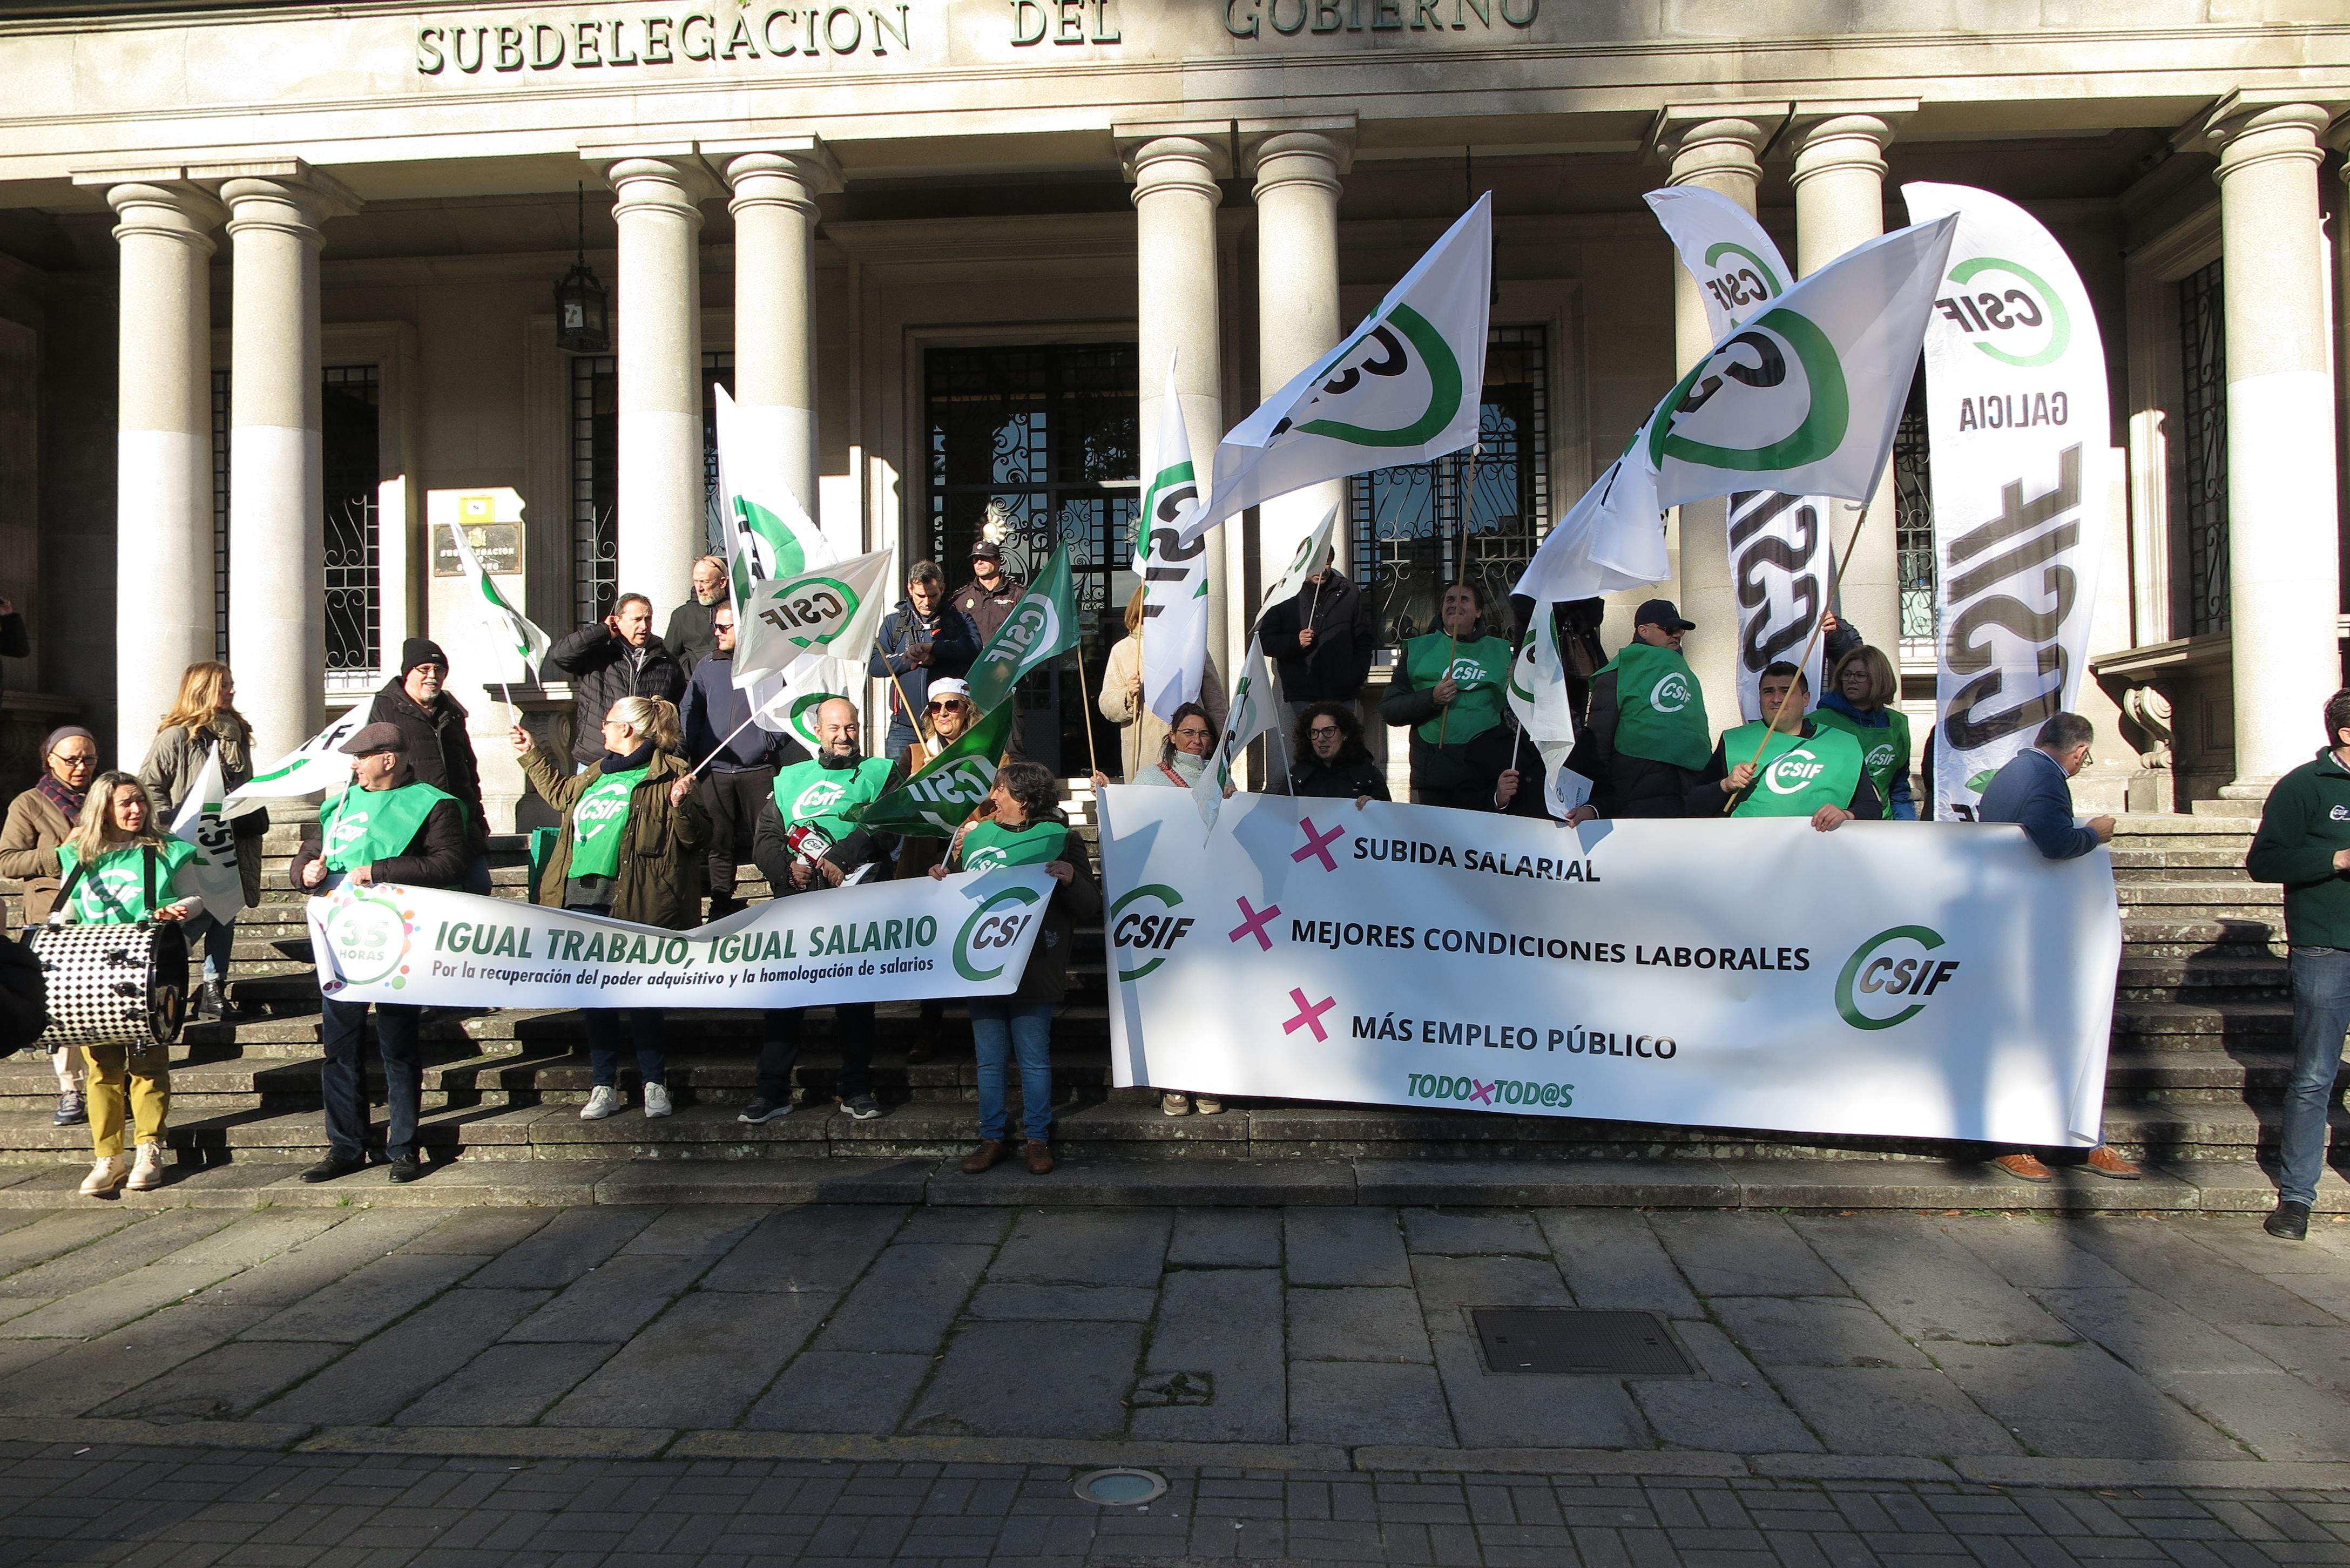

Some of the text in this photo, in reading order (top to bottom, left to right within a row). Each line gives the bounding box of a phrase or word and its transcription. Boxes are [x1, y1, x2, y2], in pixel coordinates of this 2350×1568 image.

[416, 4, 909, 75] SUBDELEGACION
[1010, 0, 1122, 45] DEL
[1451, 666, 1487, 680] CSIF
[1662, 683, 1692, 704] CSIF
[1777, 762, 1825, 779] CSIF
[1869, 753, 1896, 766] CSIF
[579, 799, 630, 821] CSIF
[802, 789, 847, 807] CSIF
[1353, 837, 1601, 882] SUBIDA SALARIAL
[341, 920, 388, 947] 35
[435, 915, 938, 969] IGUAL TRABAJO, IGUAL SALARIO
[1113, 913, 1195, 950] CSIF
[1292, 920, 1809, 971] MEJORES CONDICIONES LABORALES
[339, 949, 384, 961] HORAS
[432, 956, 934, 989] Por la recuperación del poder adquisitivo y la homologación de salarios
[1859, 957, 1961, 996] CSIF
[1352, 1012, 1676, 1059] MÁS EMPLEO PÚBLICO
